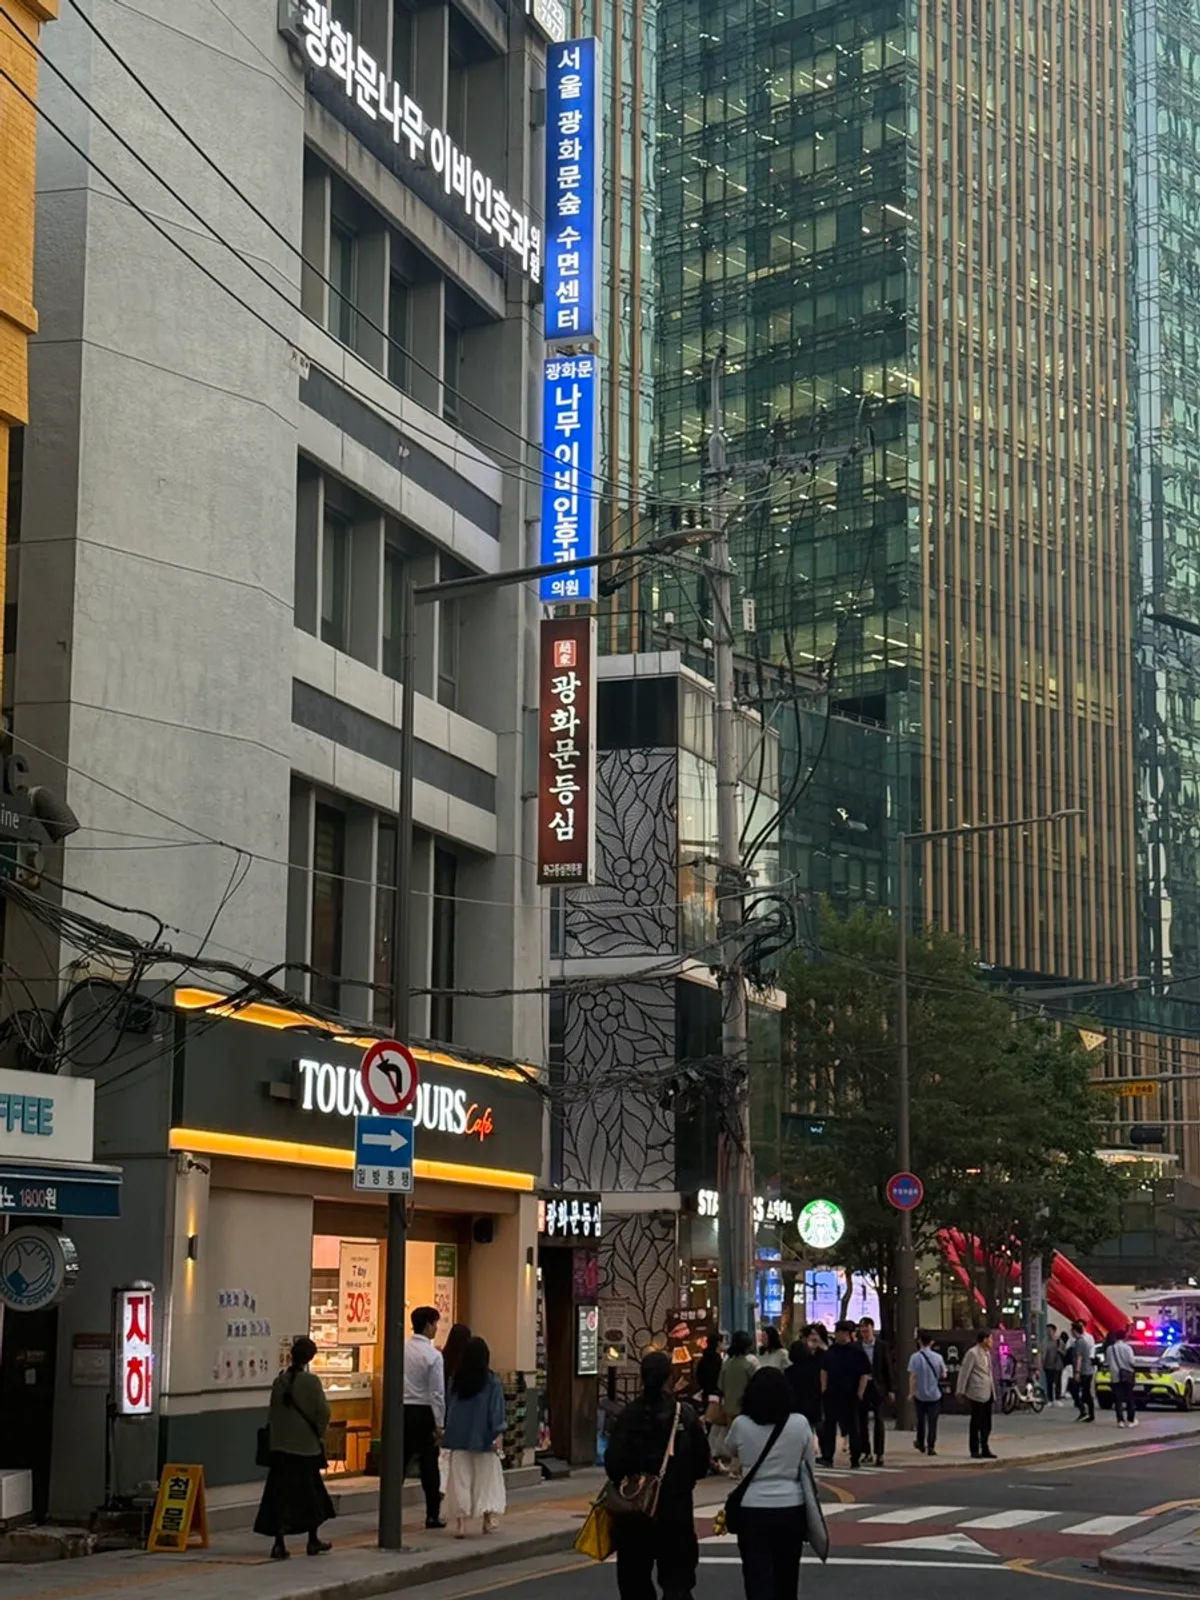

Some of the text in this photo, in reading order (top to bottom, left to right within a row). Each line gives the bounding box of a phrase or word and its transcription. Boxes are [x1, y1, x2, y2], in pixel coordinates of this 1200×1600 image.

[303, 0, 541, 283] 광화문나무 이비인후과 의원
[555, 46, 582, 331] 서울 광화문숲 수면센터
[545, 360, 594, 381] 광화문
[554, 382, 582, 438] 나무
[551, 579, 580, 597] 의원
[548, 671, 582, 842] 광화문등심
[299, 1058, 370, 1117] TOUS
[19, 1187, 57, 1210] 1800원
[358, 1168, 409, 1187] 일방통행
[546, 1199, 602, 1237] 광화문등심
[126, 1294, 151, 1408] 지하
